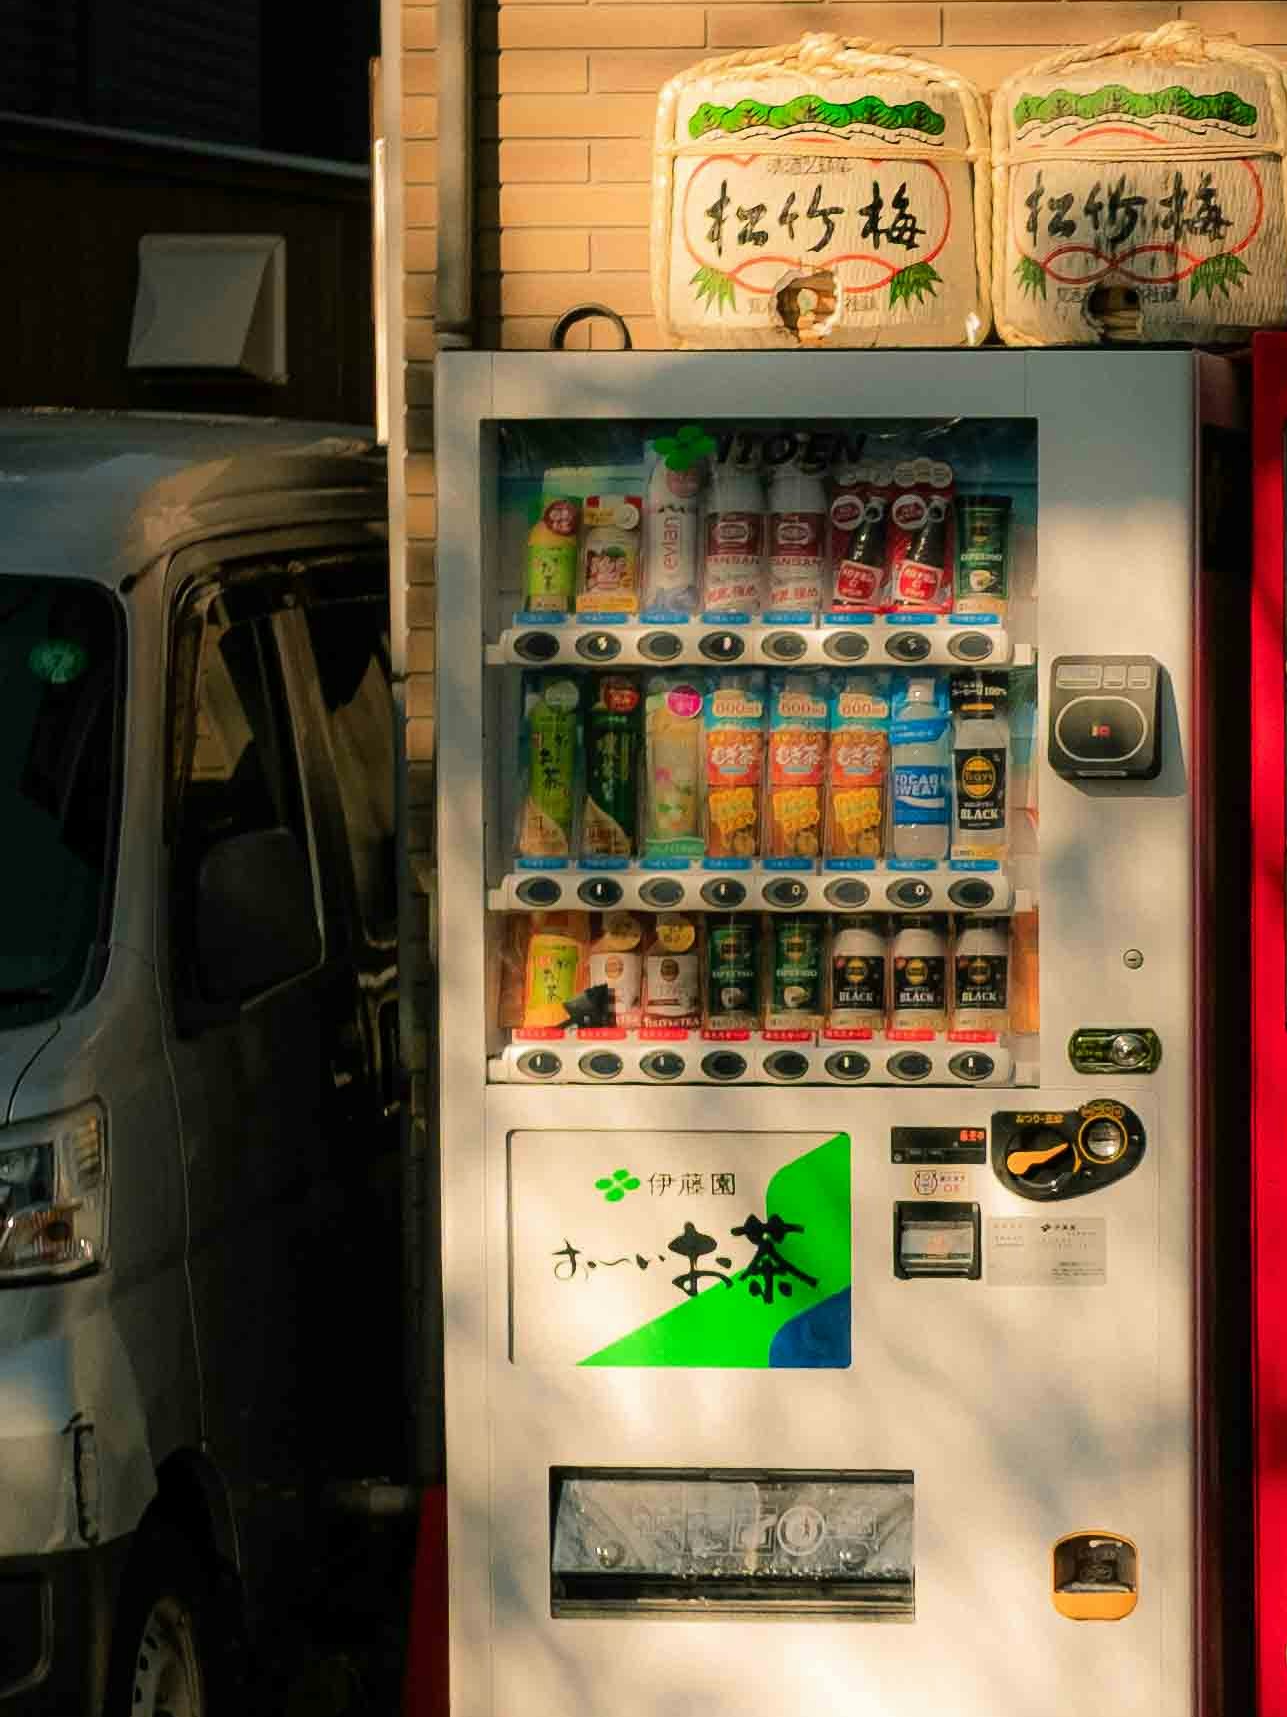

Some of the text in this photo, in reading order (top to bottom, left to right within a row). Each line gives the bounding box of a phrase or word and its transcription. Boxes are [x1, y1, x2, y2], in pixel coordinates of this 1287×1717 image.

[705, 180, 926, 257] 松竹梅
[1025, 170, 1233, 248] 松竹梅
[663, 515, 682, 572] evian
[960, 809, 999, 821] BLACK
[648, 1172, 736, 1196] 伊藤園
